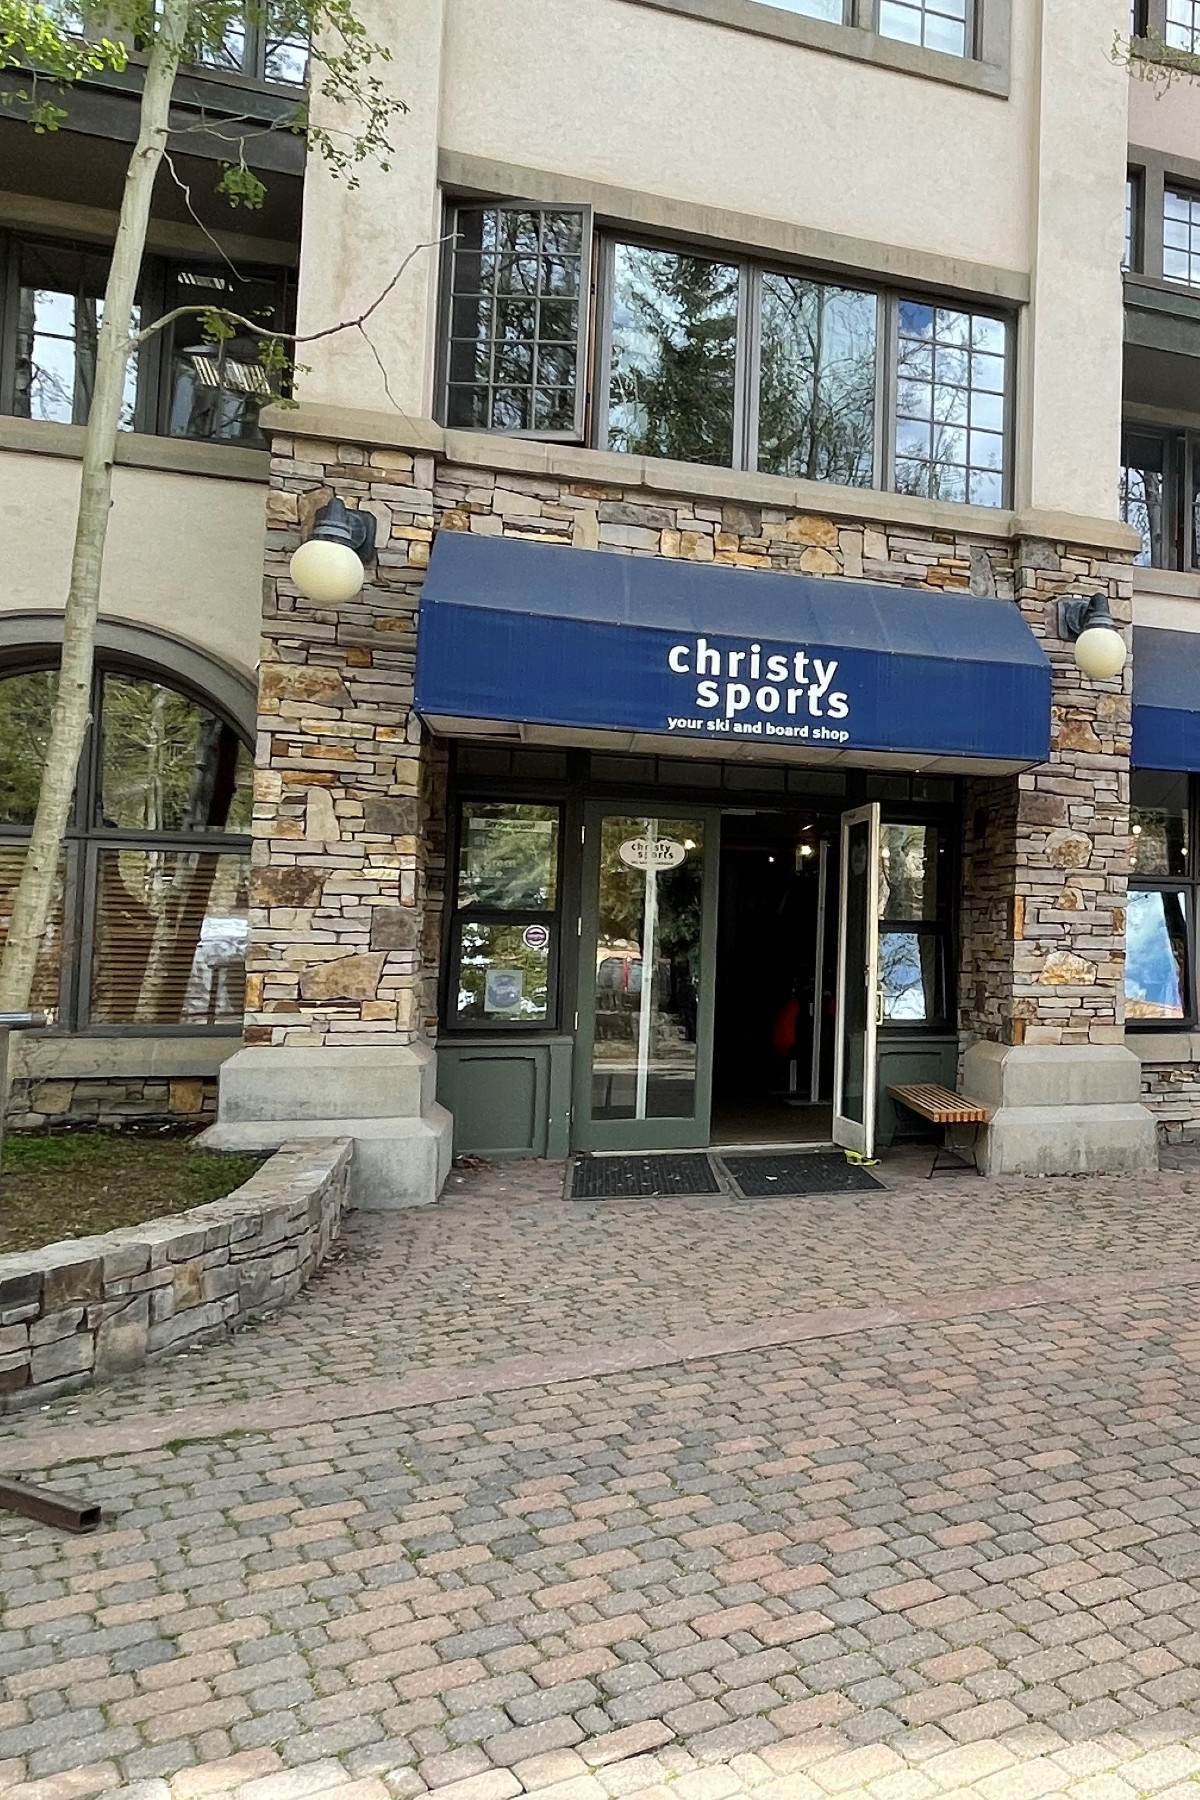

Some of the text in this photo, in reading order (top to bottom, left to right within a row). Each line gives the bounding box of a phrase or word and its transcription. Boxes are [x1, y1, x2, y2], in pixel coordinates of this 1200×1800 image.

[667, 638, 839, 698] christy
[695, 680, 850, 719] sports
[667, 716, 850, 743] your ski and board shop
[631, 842, 671, 853] chrsty
